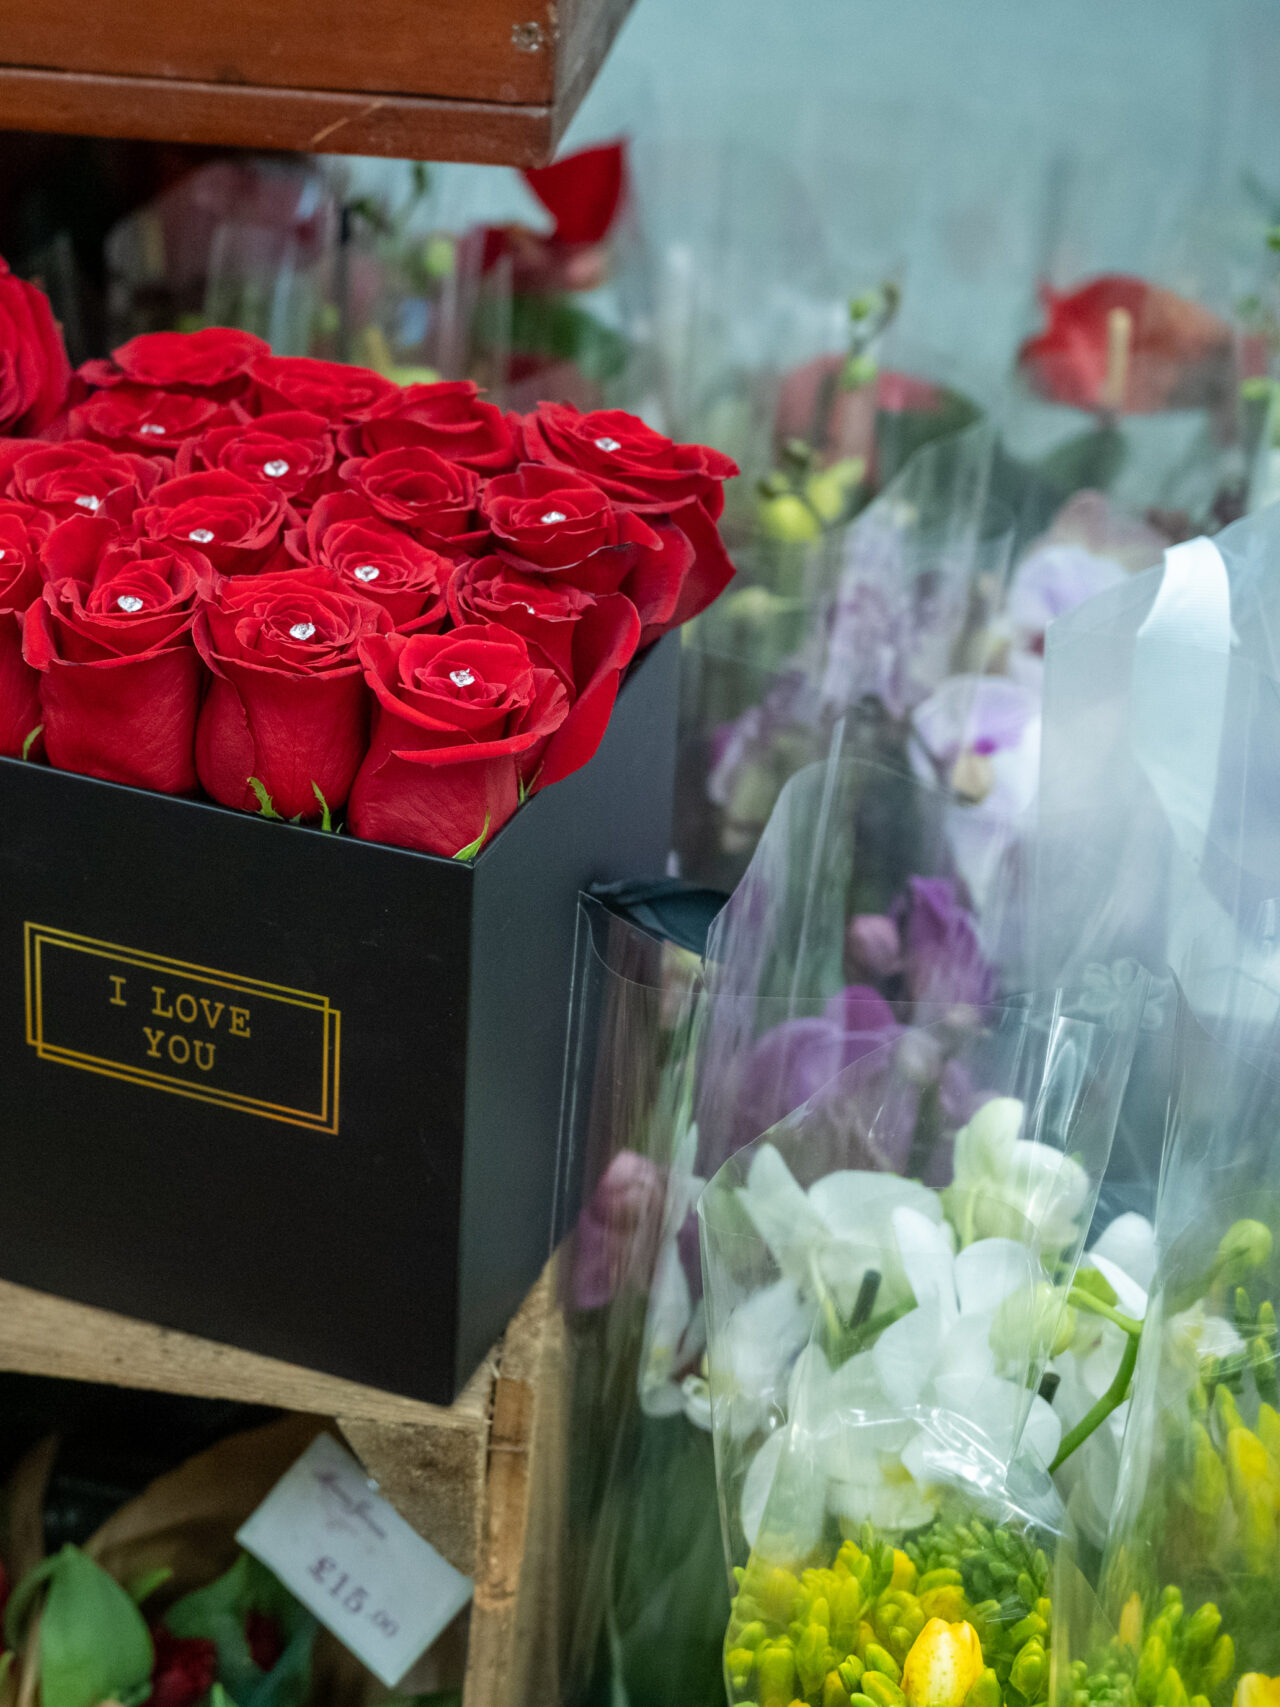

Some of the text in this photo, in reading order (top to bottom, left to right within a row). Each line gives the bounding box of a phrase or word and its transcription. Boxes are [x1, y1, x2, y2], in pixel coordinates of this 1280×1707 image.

[109, 975, 251, 1038] I LOVE
[143, 1027, 216, 1071] YOU
